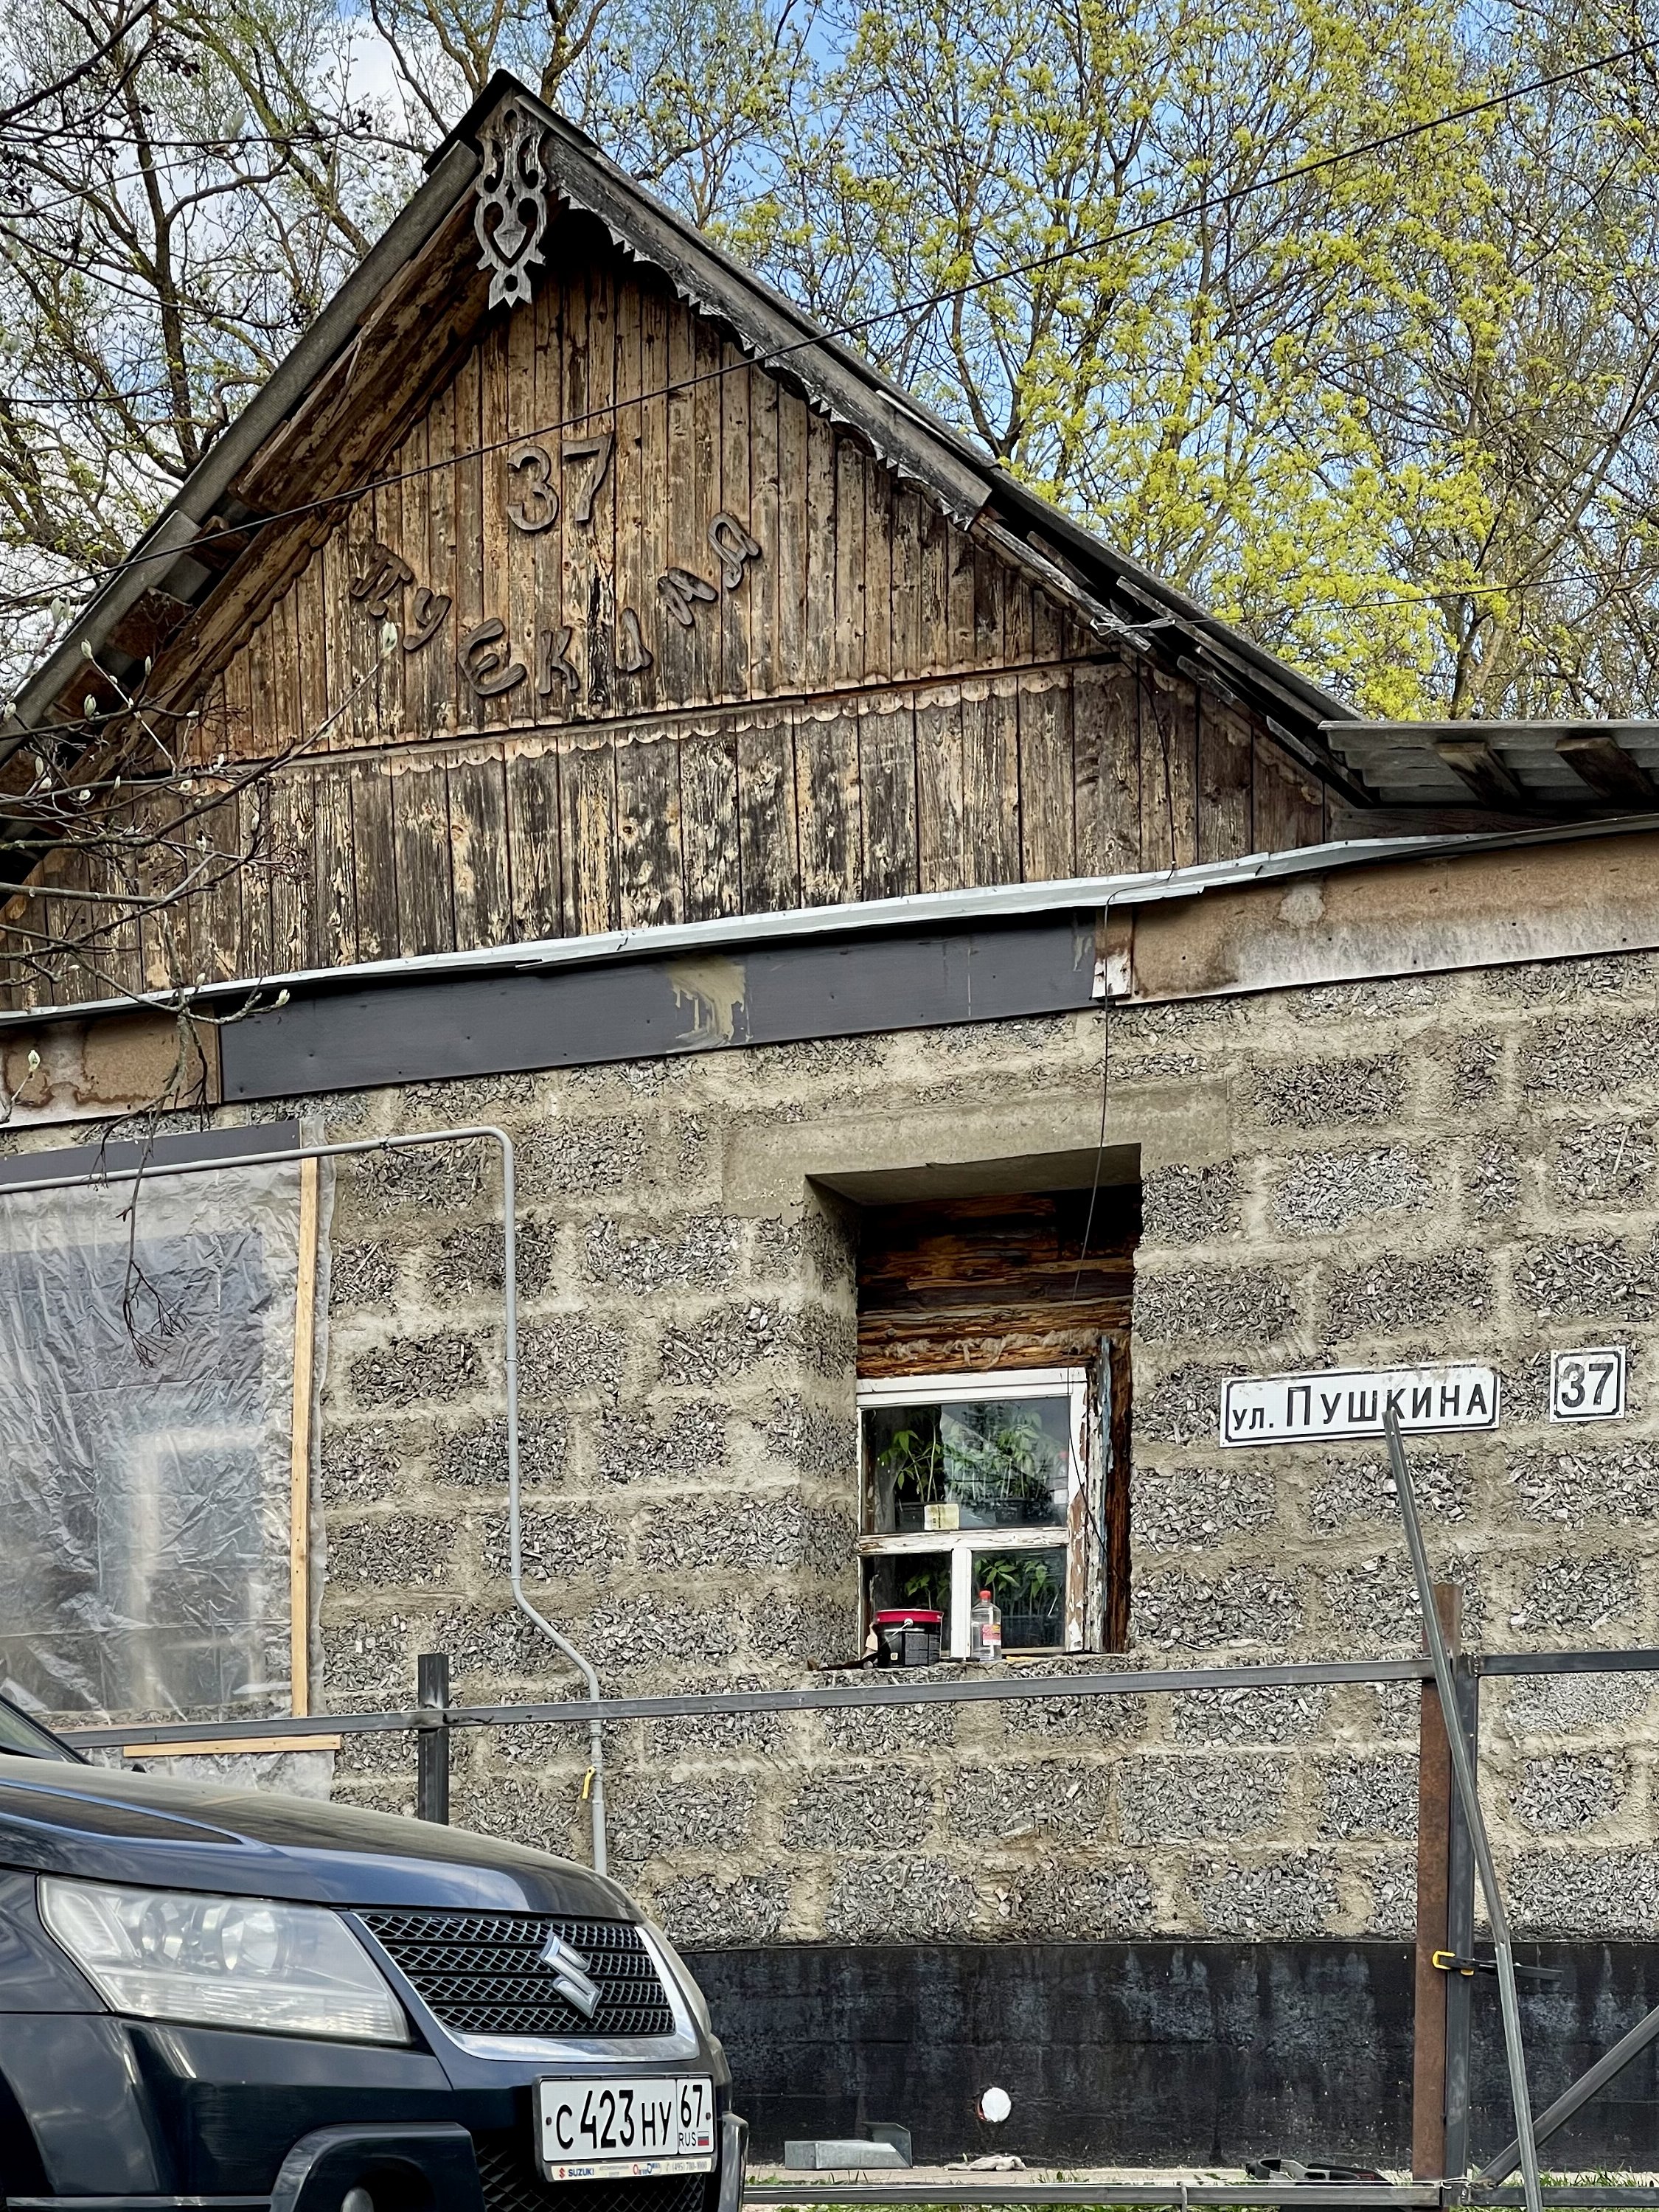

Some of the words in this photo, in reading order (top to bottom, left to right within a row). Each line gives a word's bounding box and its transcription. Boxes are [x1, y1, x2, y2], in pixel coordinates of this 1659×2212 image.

[507, 432, 614, 532] 37
[1232, 1408, 1274, 1431] ул.
[1287, 1383, 1487, 1427] ПУШКИНА
[1561, 1362, 1614, 1408] 37
[681, 2084, 703, 2128] 67
[678, 2132, 697, 2147] RUS
[568, 2168, 594, 2177] SUZUKI
